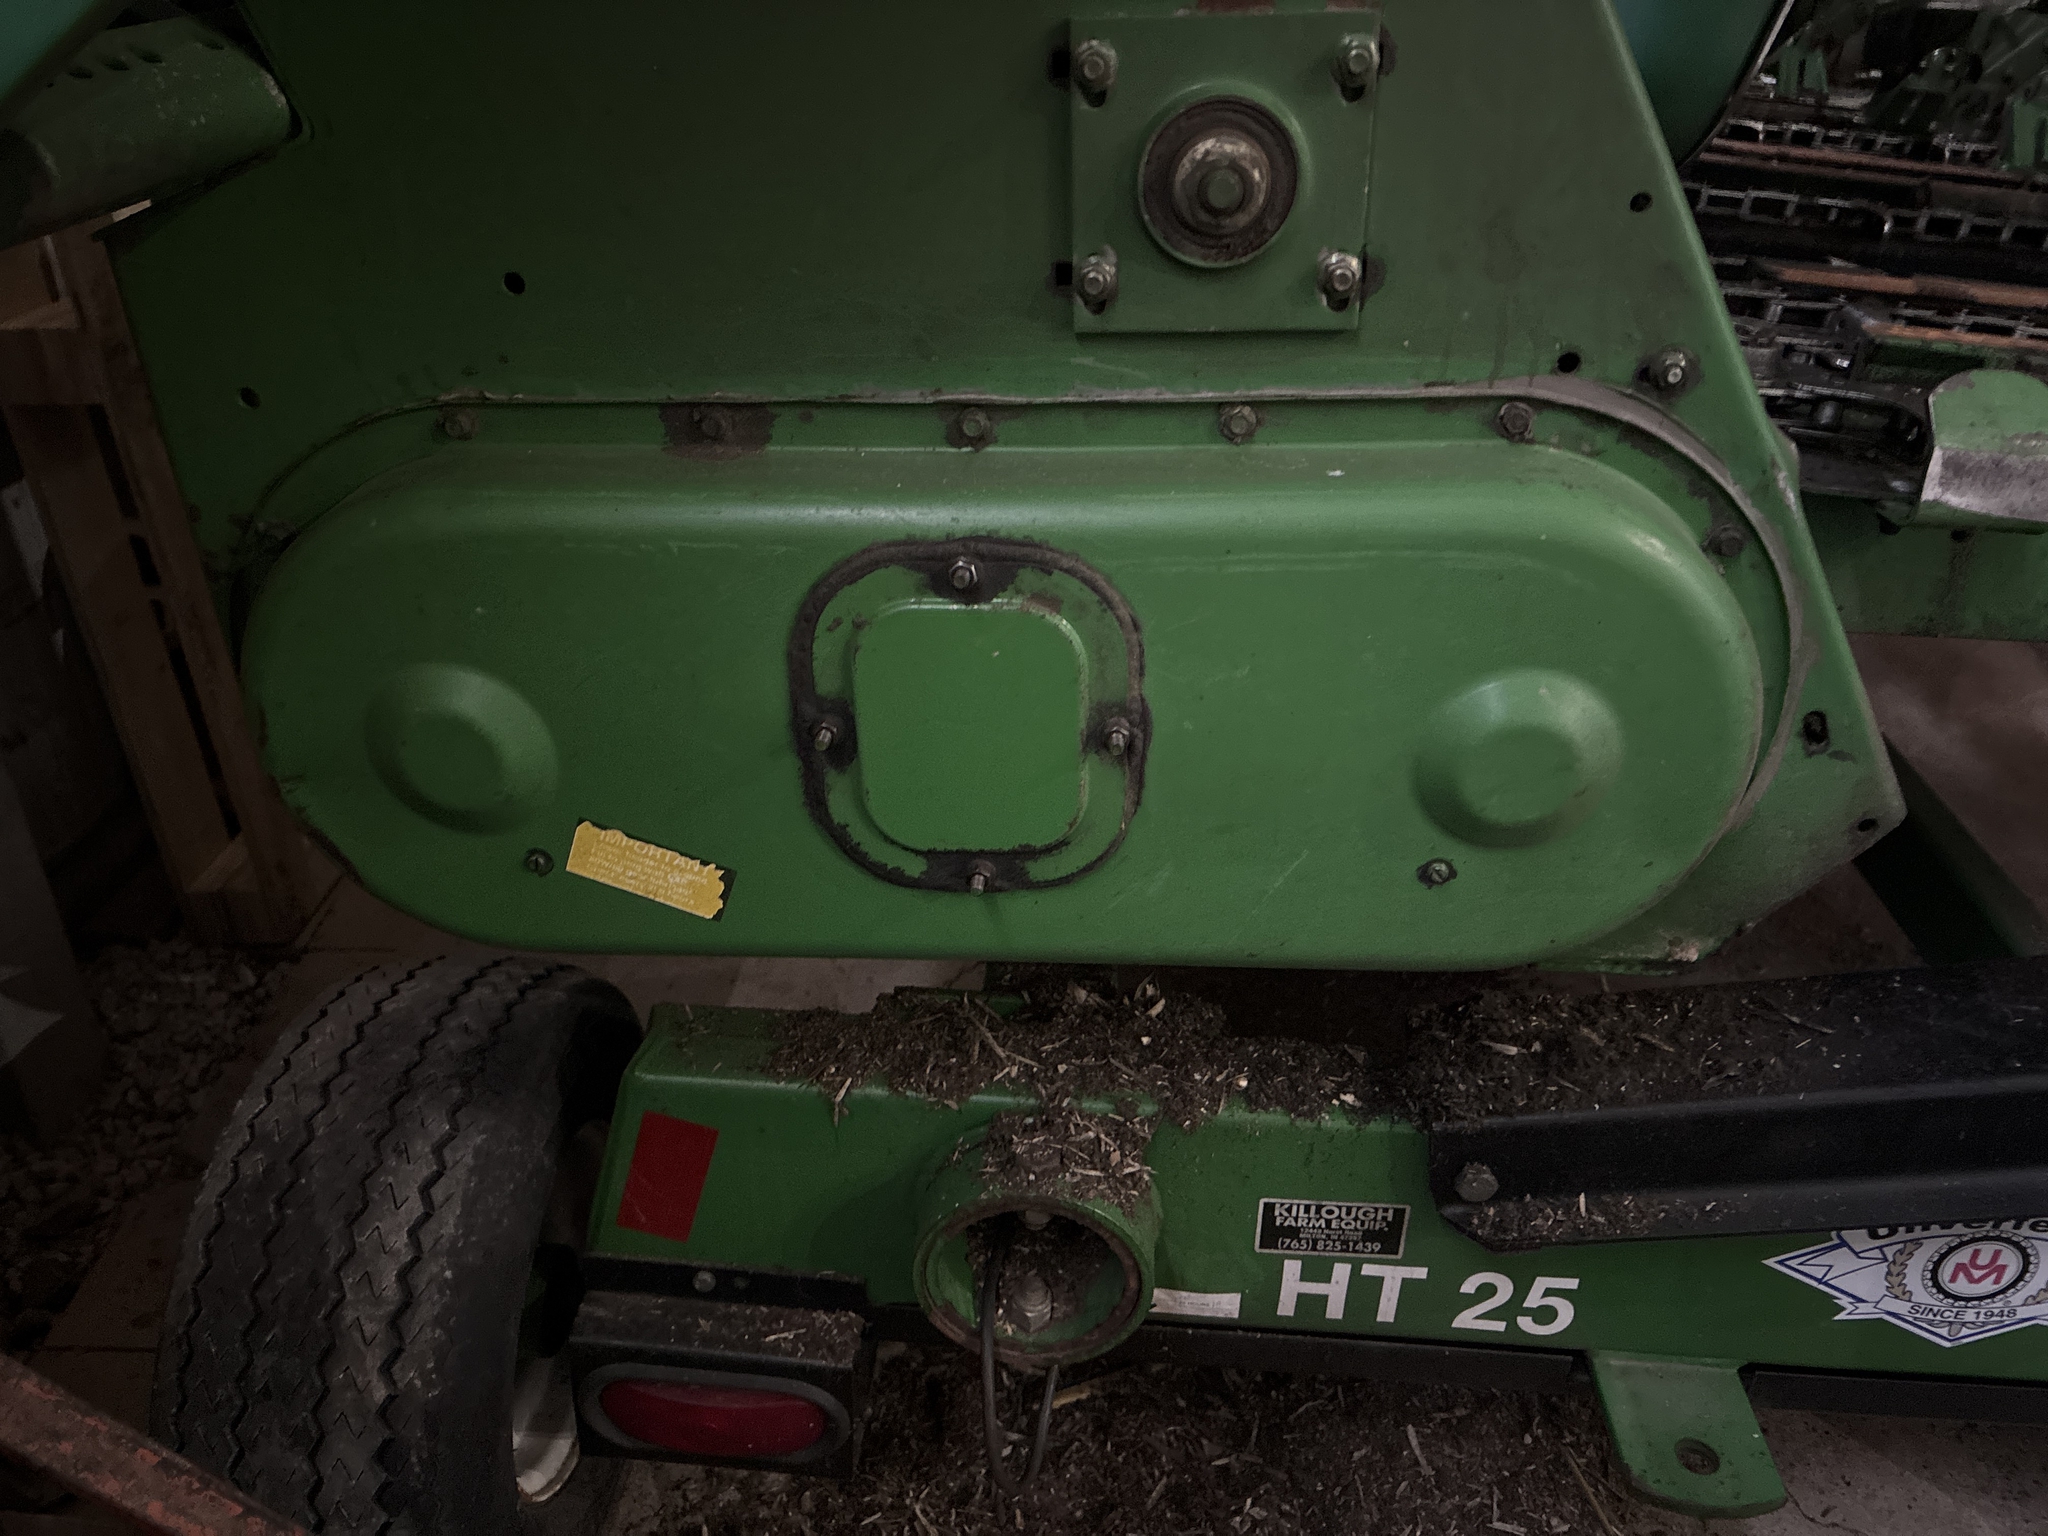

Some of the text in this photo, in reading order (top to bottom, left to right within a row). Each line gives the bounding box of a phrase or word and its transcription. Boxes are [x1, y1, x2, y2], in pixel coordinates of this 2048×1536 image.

[1274, 1204, 1394, 1221] KILLOUGH
[1276, 1217, 1389, 1231] FARM EQUIP.
[1278, 1237, 1382, 1253] (765) 825-1439
[1276, 1259, 1580, 1336] HT 25
[1907, 1305, 2018, 1320] SINCE 1948
